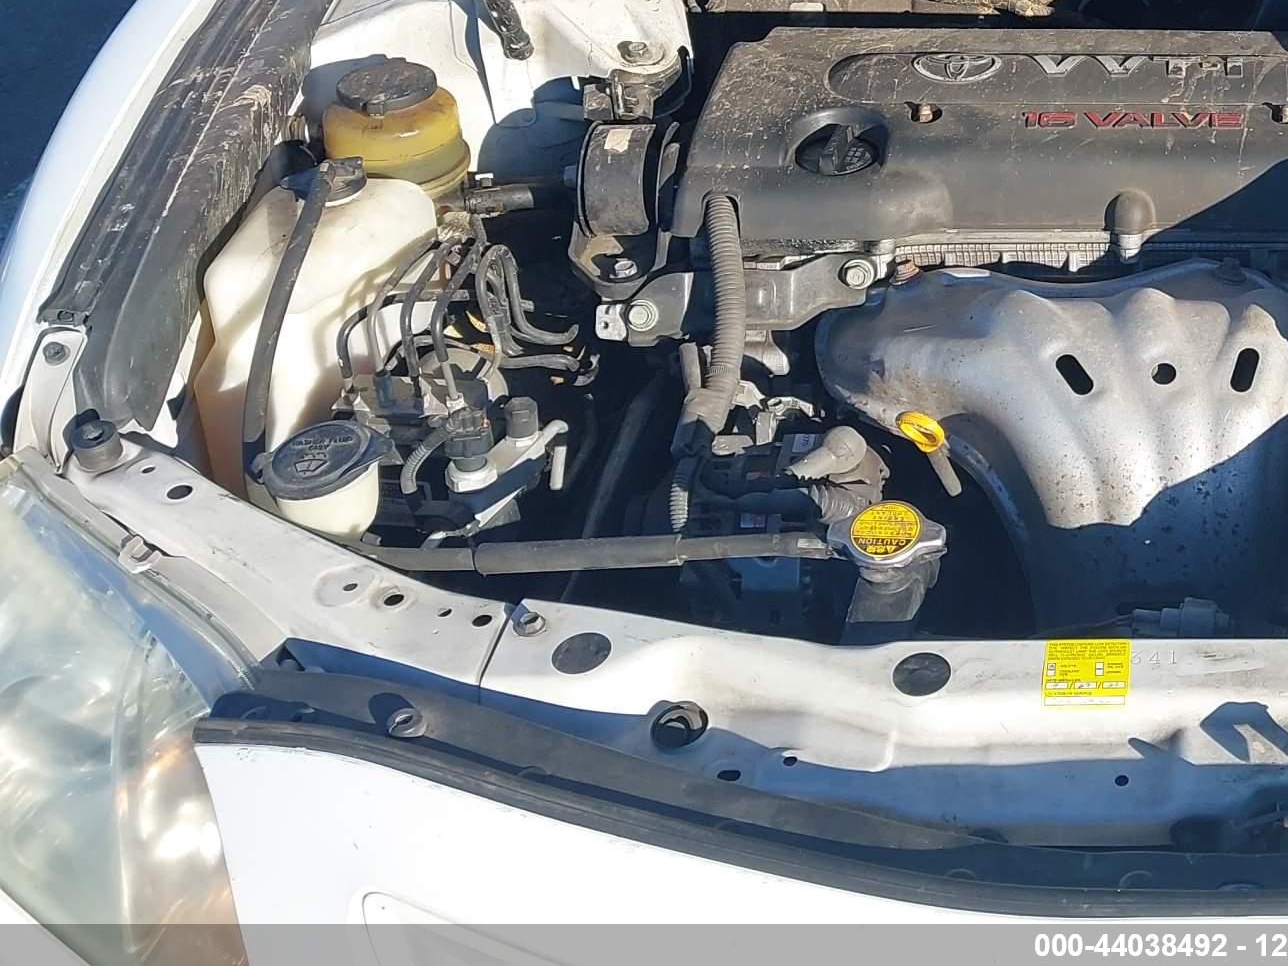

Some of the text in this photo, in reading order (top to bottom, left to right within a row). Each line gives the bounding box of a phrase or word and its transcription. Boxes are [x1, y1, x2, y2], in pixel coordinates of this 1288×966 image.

[1022, 111, 1244, 130] 16 VALVE
[857, 538, 906, 546] CAUTION
